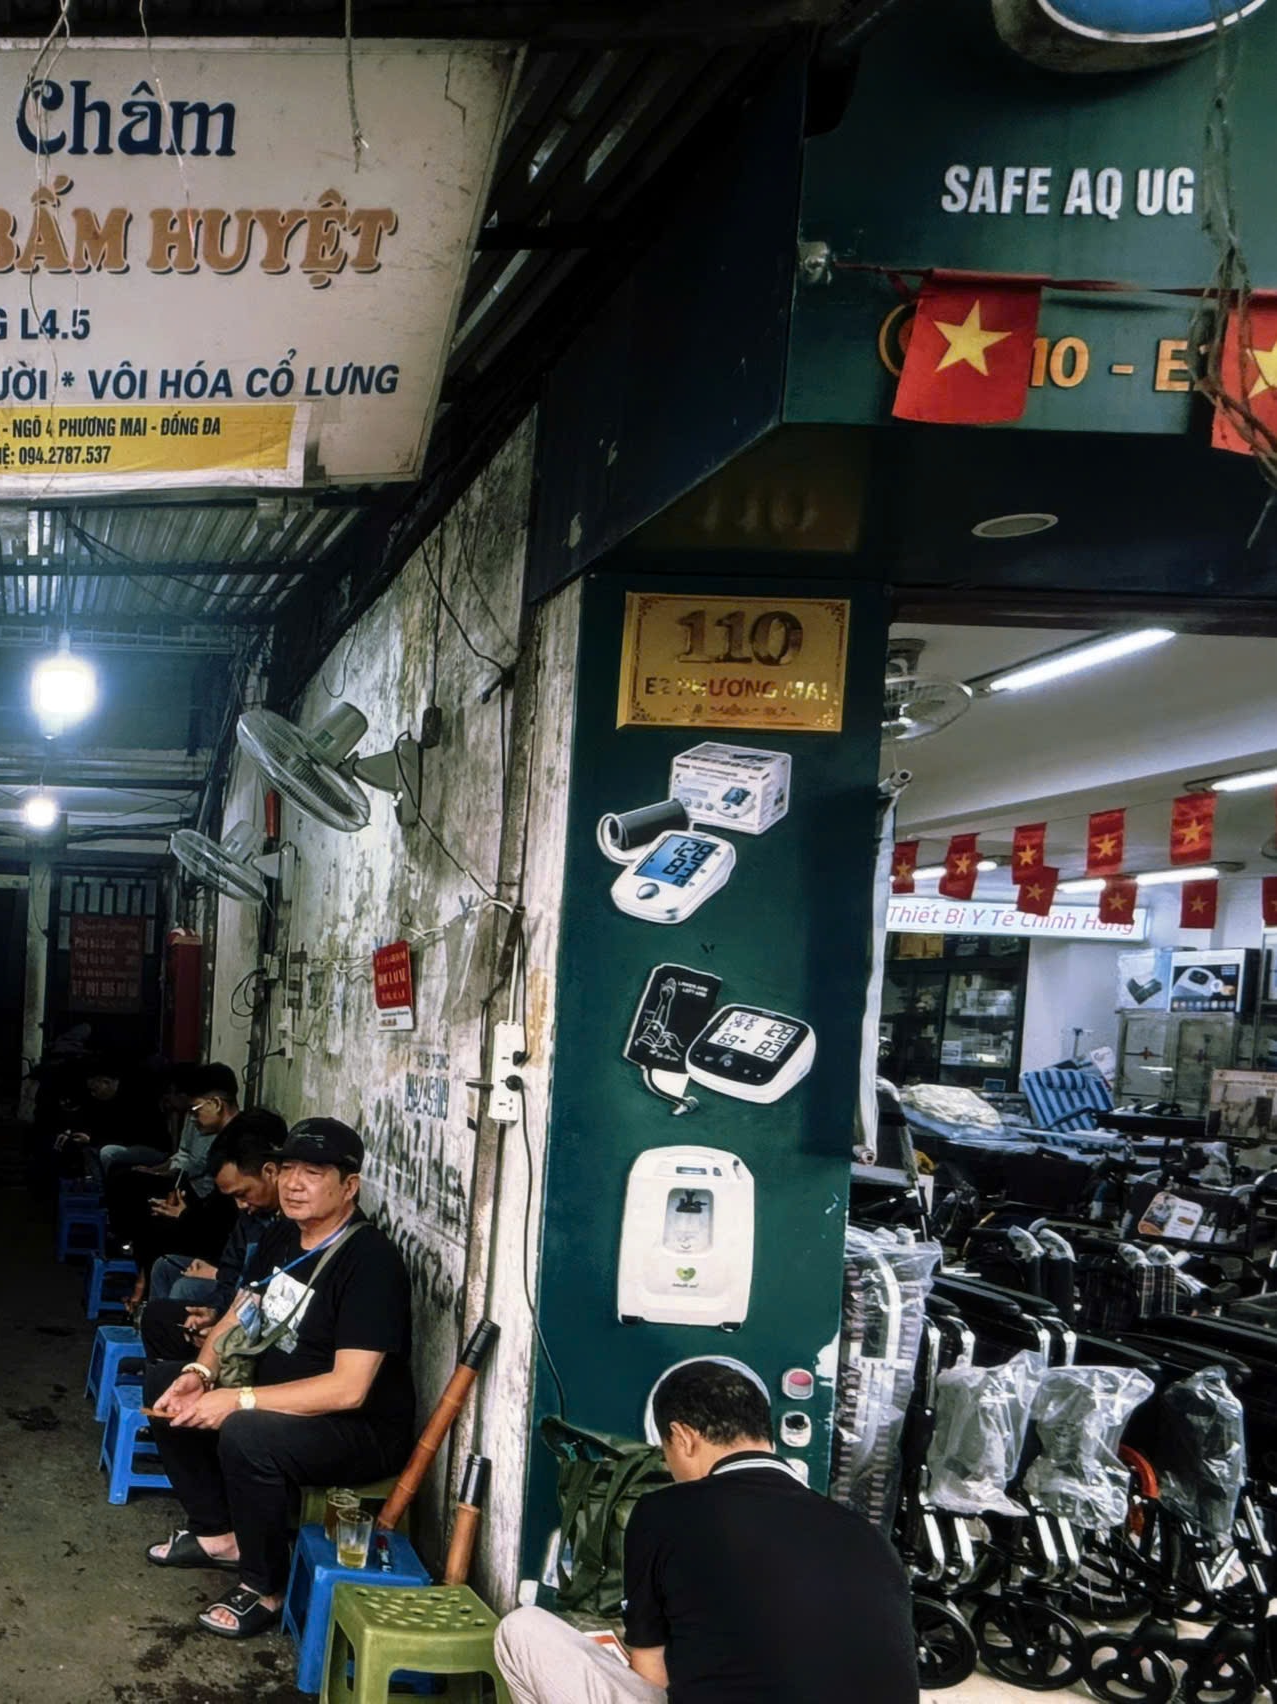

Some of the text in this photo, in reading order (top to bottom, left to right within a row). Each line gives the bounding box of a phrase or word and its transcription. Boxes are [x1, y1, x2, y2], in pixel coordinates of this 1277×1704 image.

[17, 81, 237, 157] Châm
[941, 165, 1195, 220] SAFE AQ UG
[147, 188, 399, 290] HUYỆT
[20, 309, 91, 342] L4.5
[88, 362, 149, 400] VÔI
[160, 360, 234, 399] HÓA
[245, 349, 297, 397] CỔ
[304, 364, 400, 396] LƯNG
[12, 413, 42, 439] NGÕ
[59, 414, 116, 437] PHƯƠNG
[120, 417, 148, 437] MAI
[160, 410, 199, 437] ĐỐNG
[202, 416, 221, 436] ĐA
[18, 445, 112, 466] 094.2787.537
[676, 609, 804, 667] 110
[673, 840, 713, 862] 128
[888, 903, 941, 925] Thiết
[944, 907, 965, 929] Bị
[972, 908, 987, 925] Y
